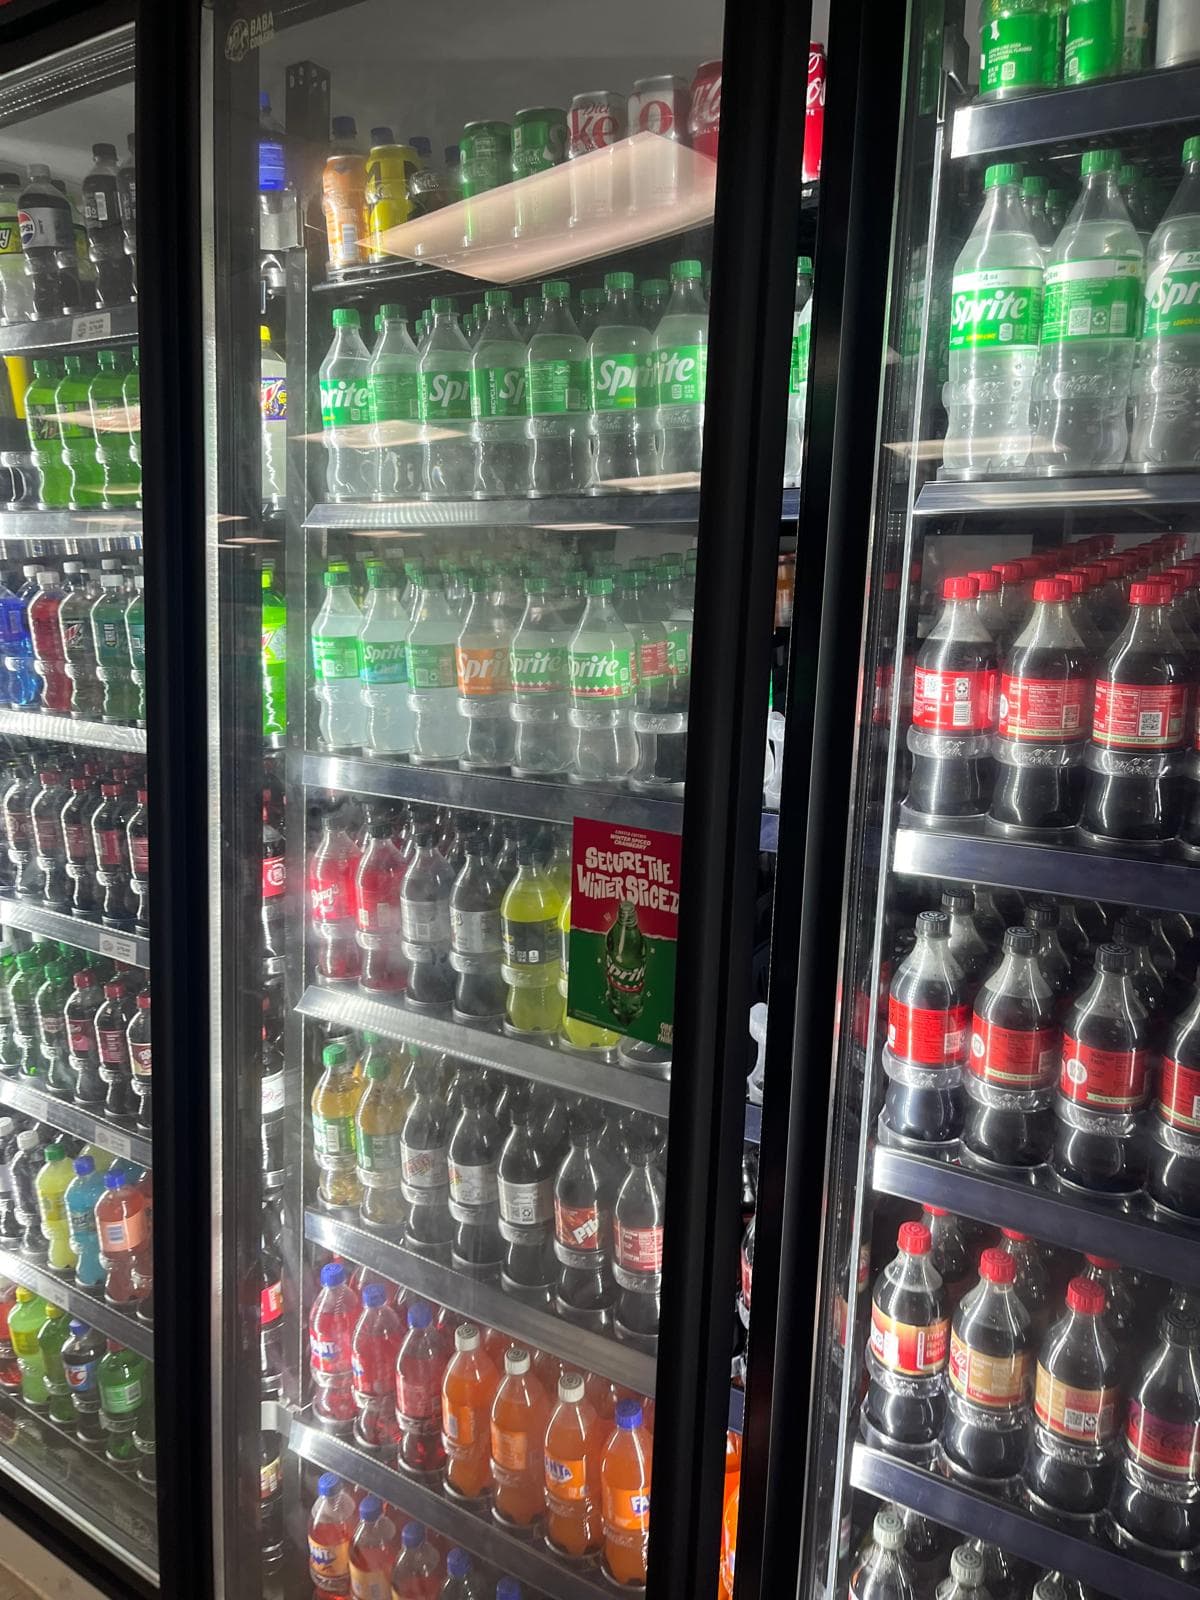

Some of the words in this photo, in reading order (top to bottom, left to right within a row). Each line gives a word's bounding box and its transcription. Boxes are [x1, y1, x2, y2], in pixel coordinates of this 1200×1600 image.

[952, 290, 1028, 331] Sprite
[1151, 277, 1200, 315] Spr
[490, 370, 497, 382] ME
[490, 383, 498, 416] RECYCLE
[576, 863, 626, 901] WINTER
[585, 846, 646, 873] SECURE
[643, 854, 674, 885] THE
